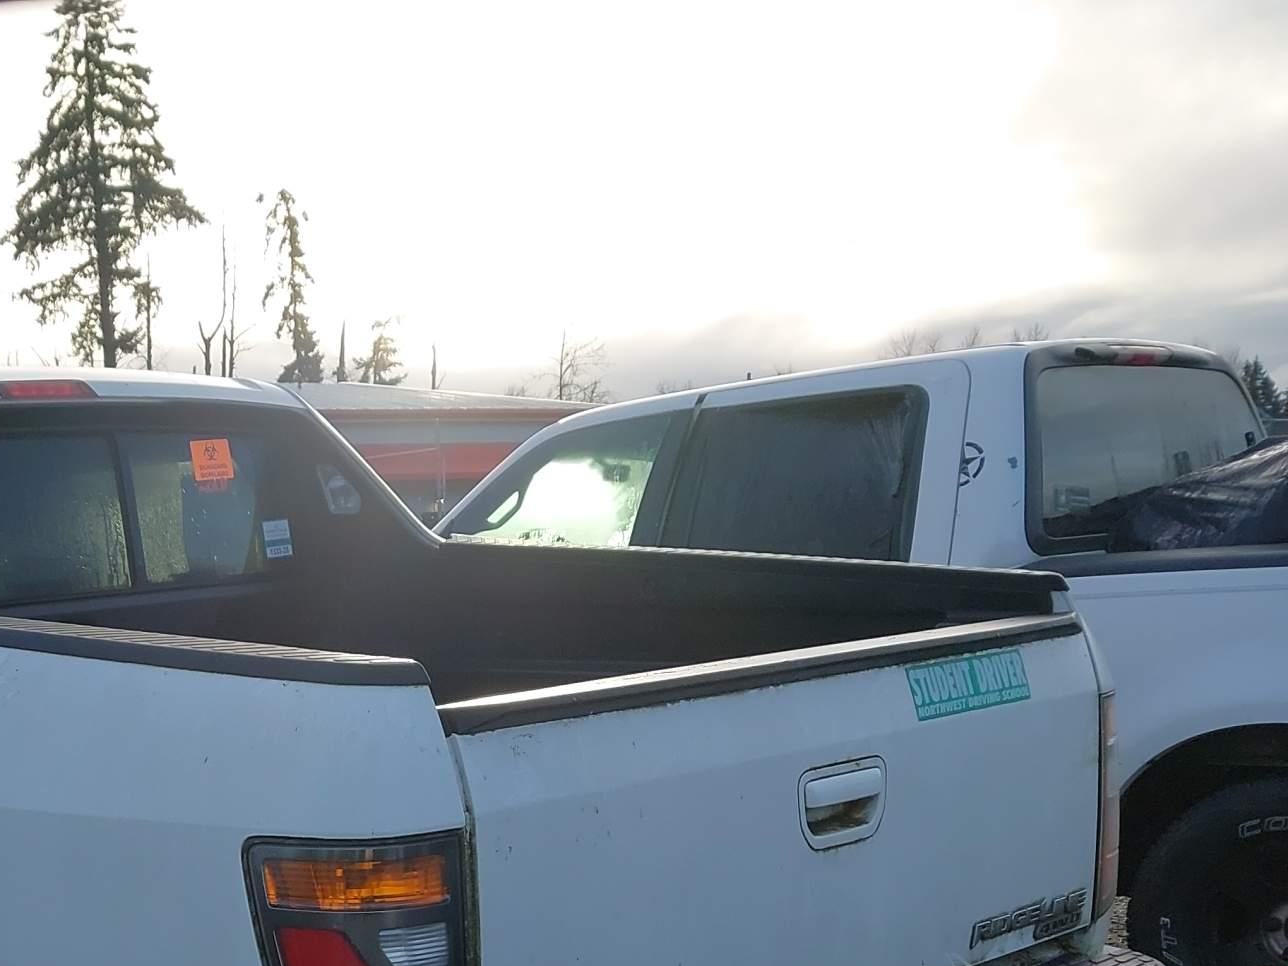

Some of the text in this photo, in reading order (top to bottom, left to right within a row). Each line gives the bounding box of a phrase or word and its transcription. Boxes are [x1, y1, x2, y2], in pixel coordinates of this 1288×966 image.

[908, 652, 1028, 706] STUDENT DRIVER
[918, 686, 1030, 717] NORTHWEST DRIVING SCHOOL
